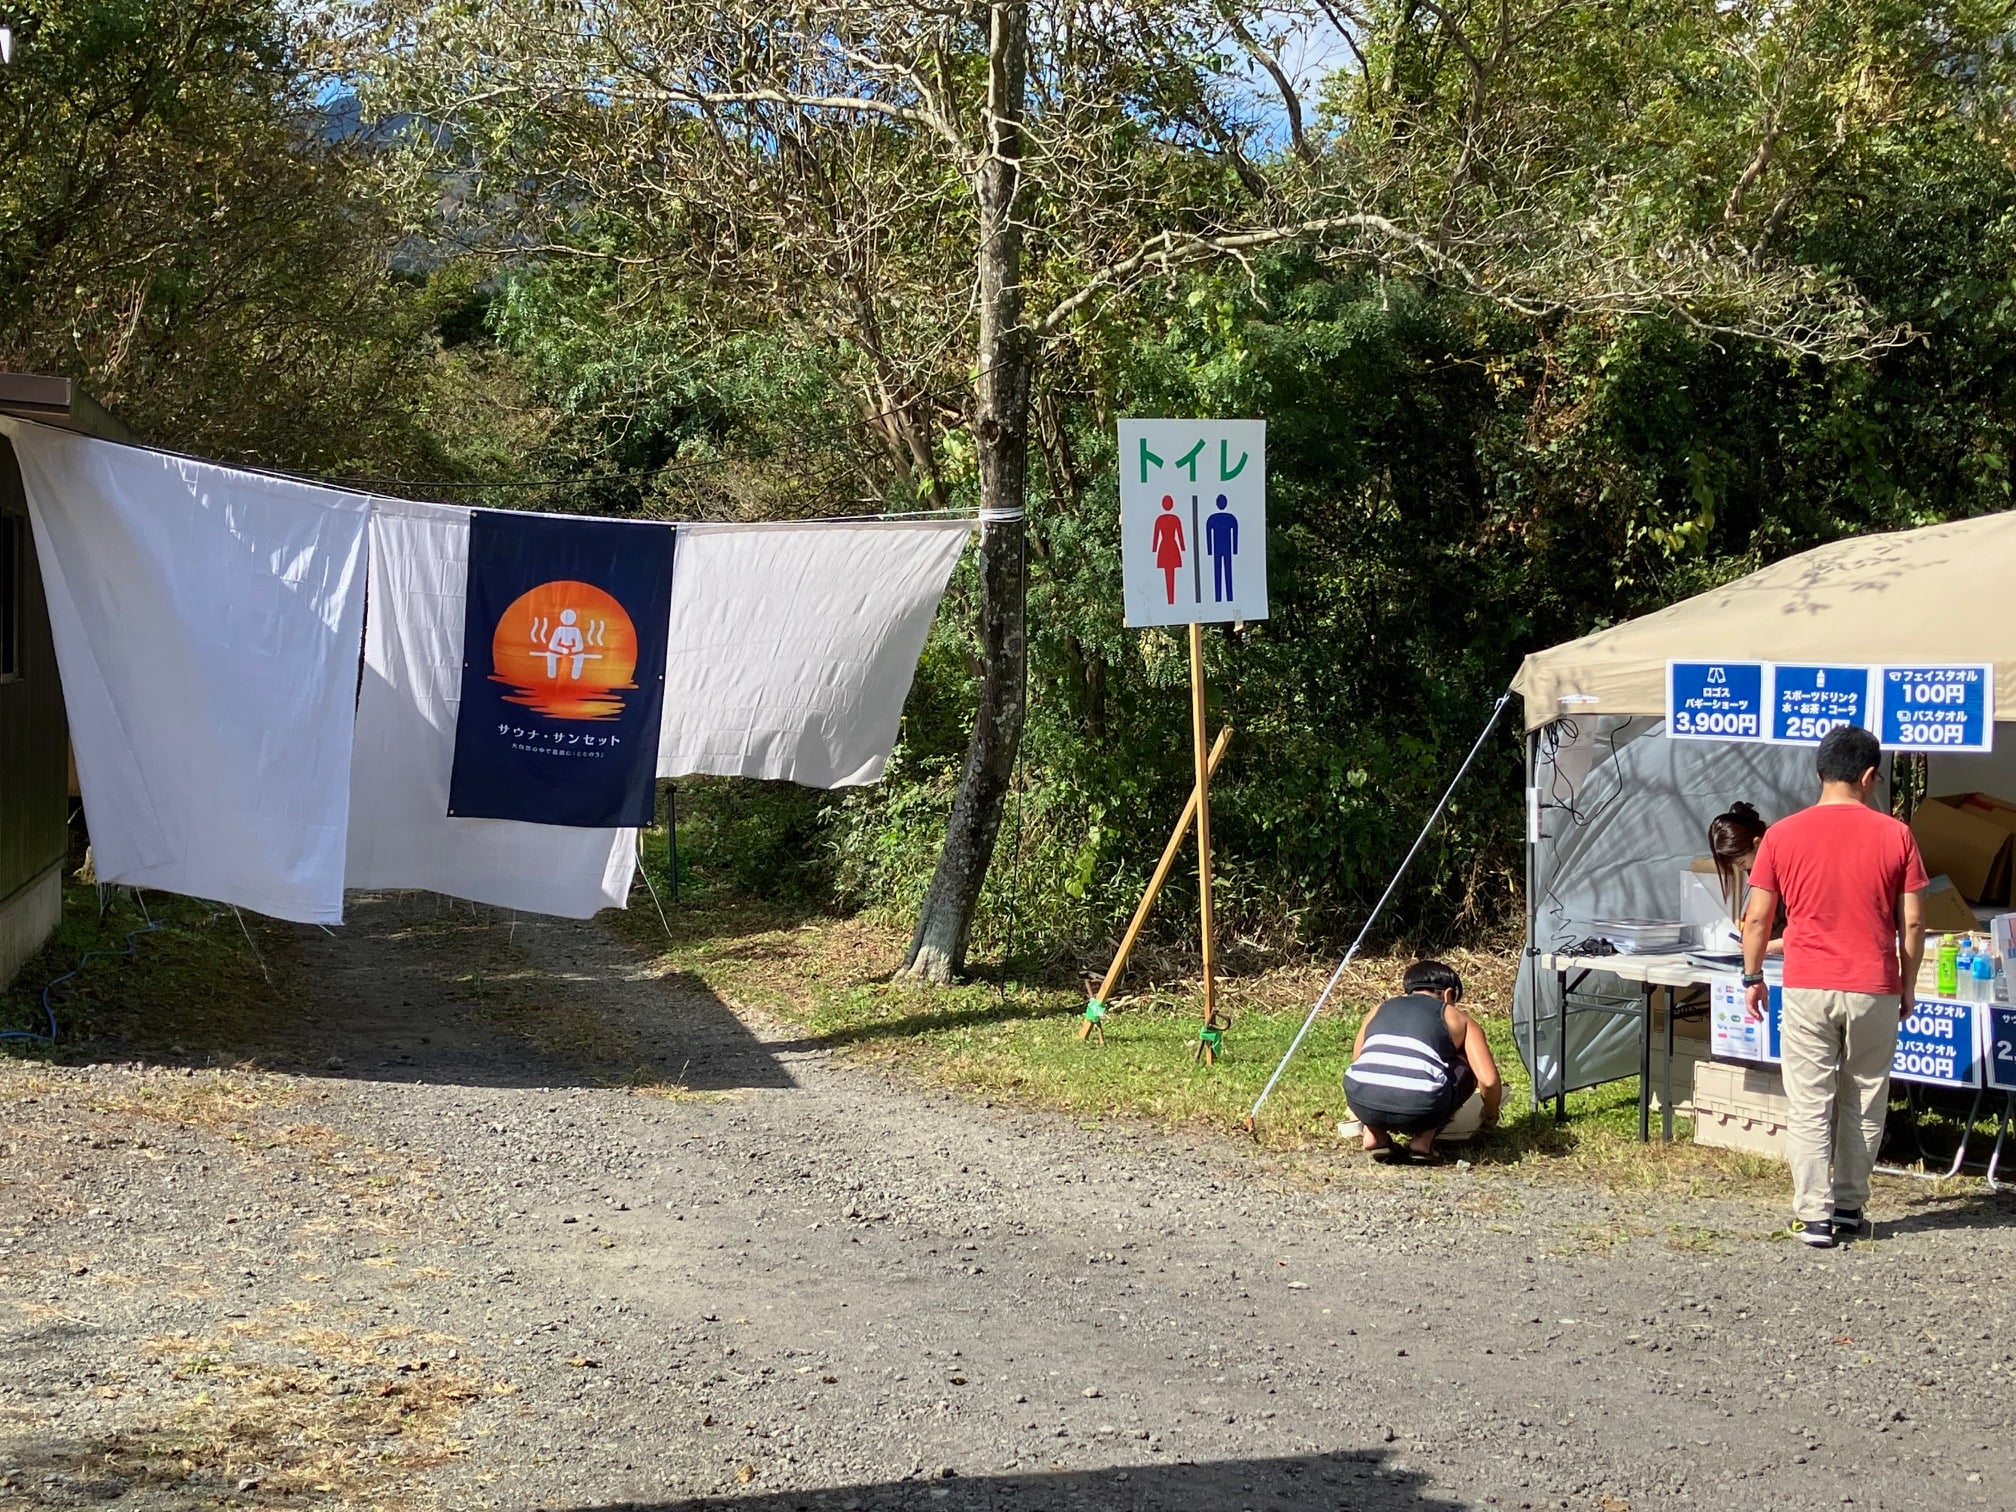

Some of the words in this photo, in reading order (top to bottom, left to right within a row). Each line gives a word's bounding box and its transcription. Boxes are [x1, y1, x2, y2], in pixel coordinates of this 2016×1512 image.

[1140, 438, 1249, 483] トイレ
[1903, 670, 1978, 682] フェイスタオル
[1703, 687, 1731, 698] ロゴス
[1783, 690, 1858, 703] スポーツドリンク
[1902, 684, 1965, 704] 100円
[1685, 698, 1748, 710] バギーショーツ
[1782, 702, 1857, 716] 水・お茶・コーラ
[1676, 711, 1757, 735] 3,900円
[1912, 710, 1968, 722] バスタオル
[498, 723, 620, 747] サウナ・サンセット
[1899, 723, 1964, 744] 300円
[1911, 1003, 1966, 1019] イスタオル
[1904, 1040, 1957, 1057] バスタオル
[1893, 1052, 1954, 1079] 300円
